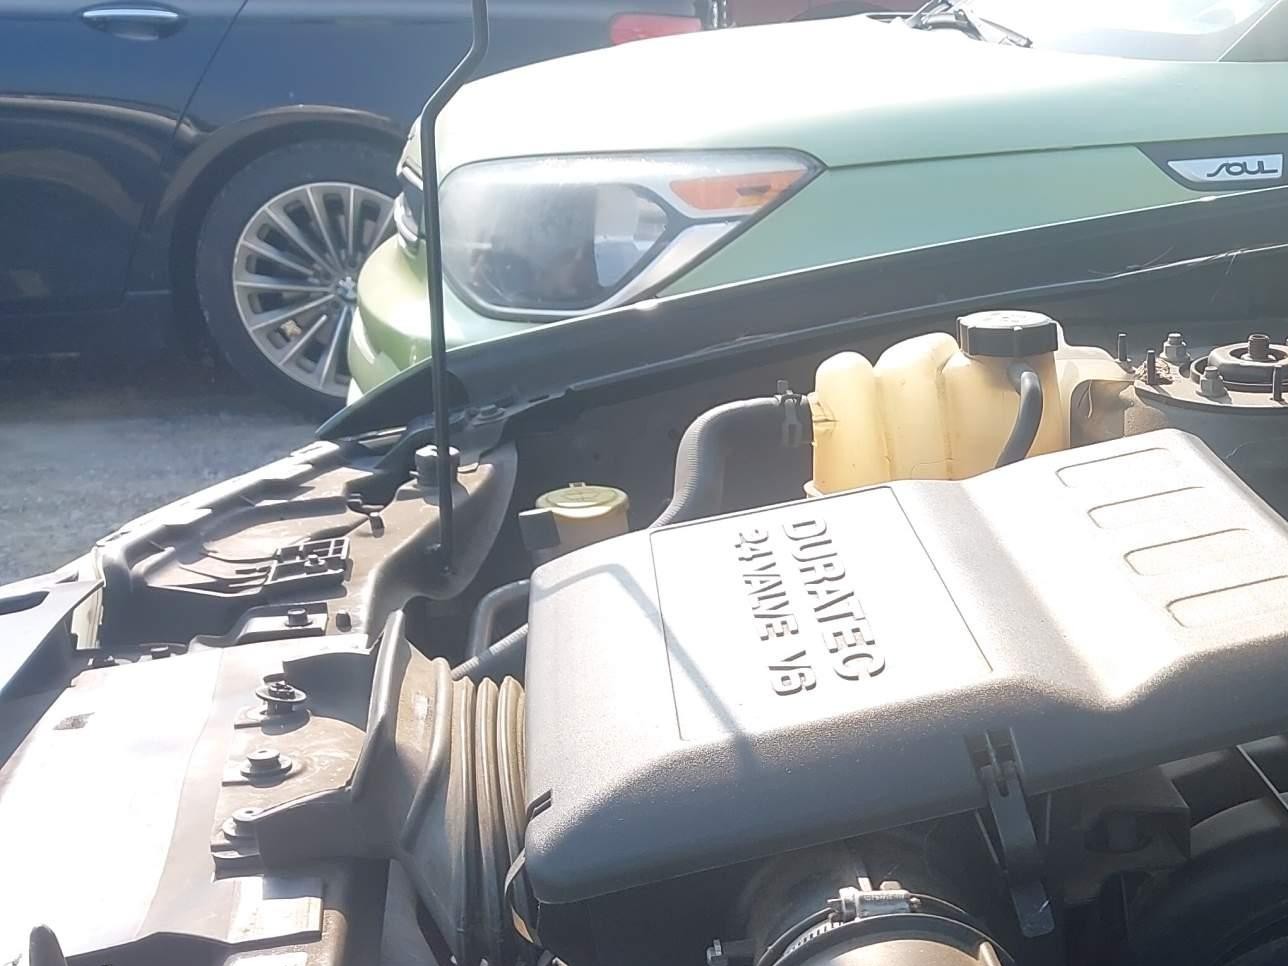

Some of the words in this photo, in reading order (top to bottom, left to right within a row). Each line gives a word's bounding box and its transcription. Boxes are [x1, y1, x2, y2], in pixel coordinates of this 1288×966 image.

[1206, 160, 1279, 178] SOUL
[783, 517, 886, 681] DURATEC
[767, 648, 818, 697] V6
